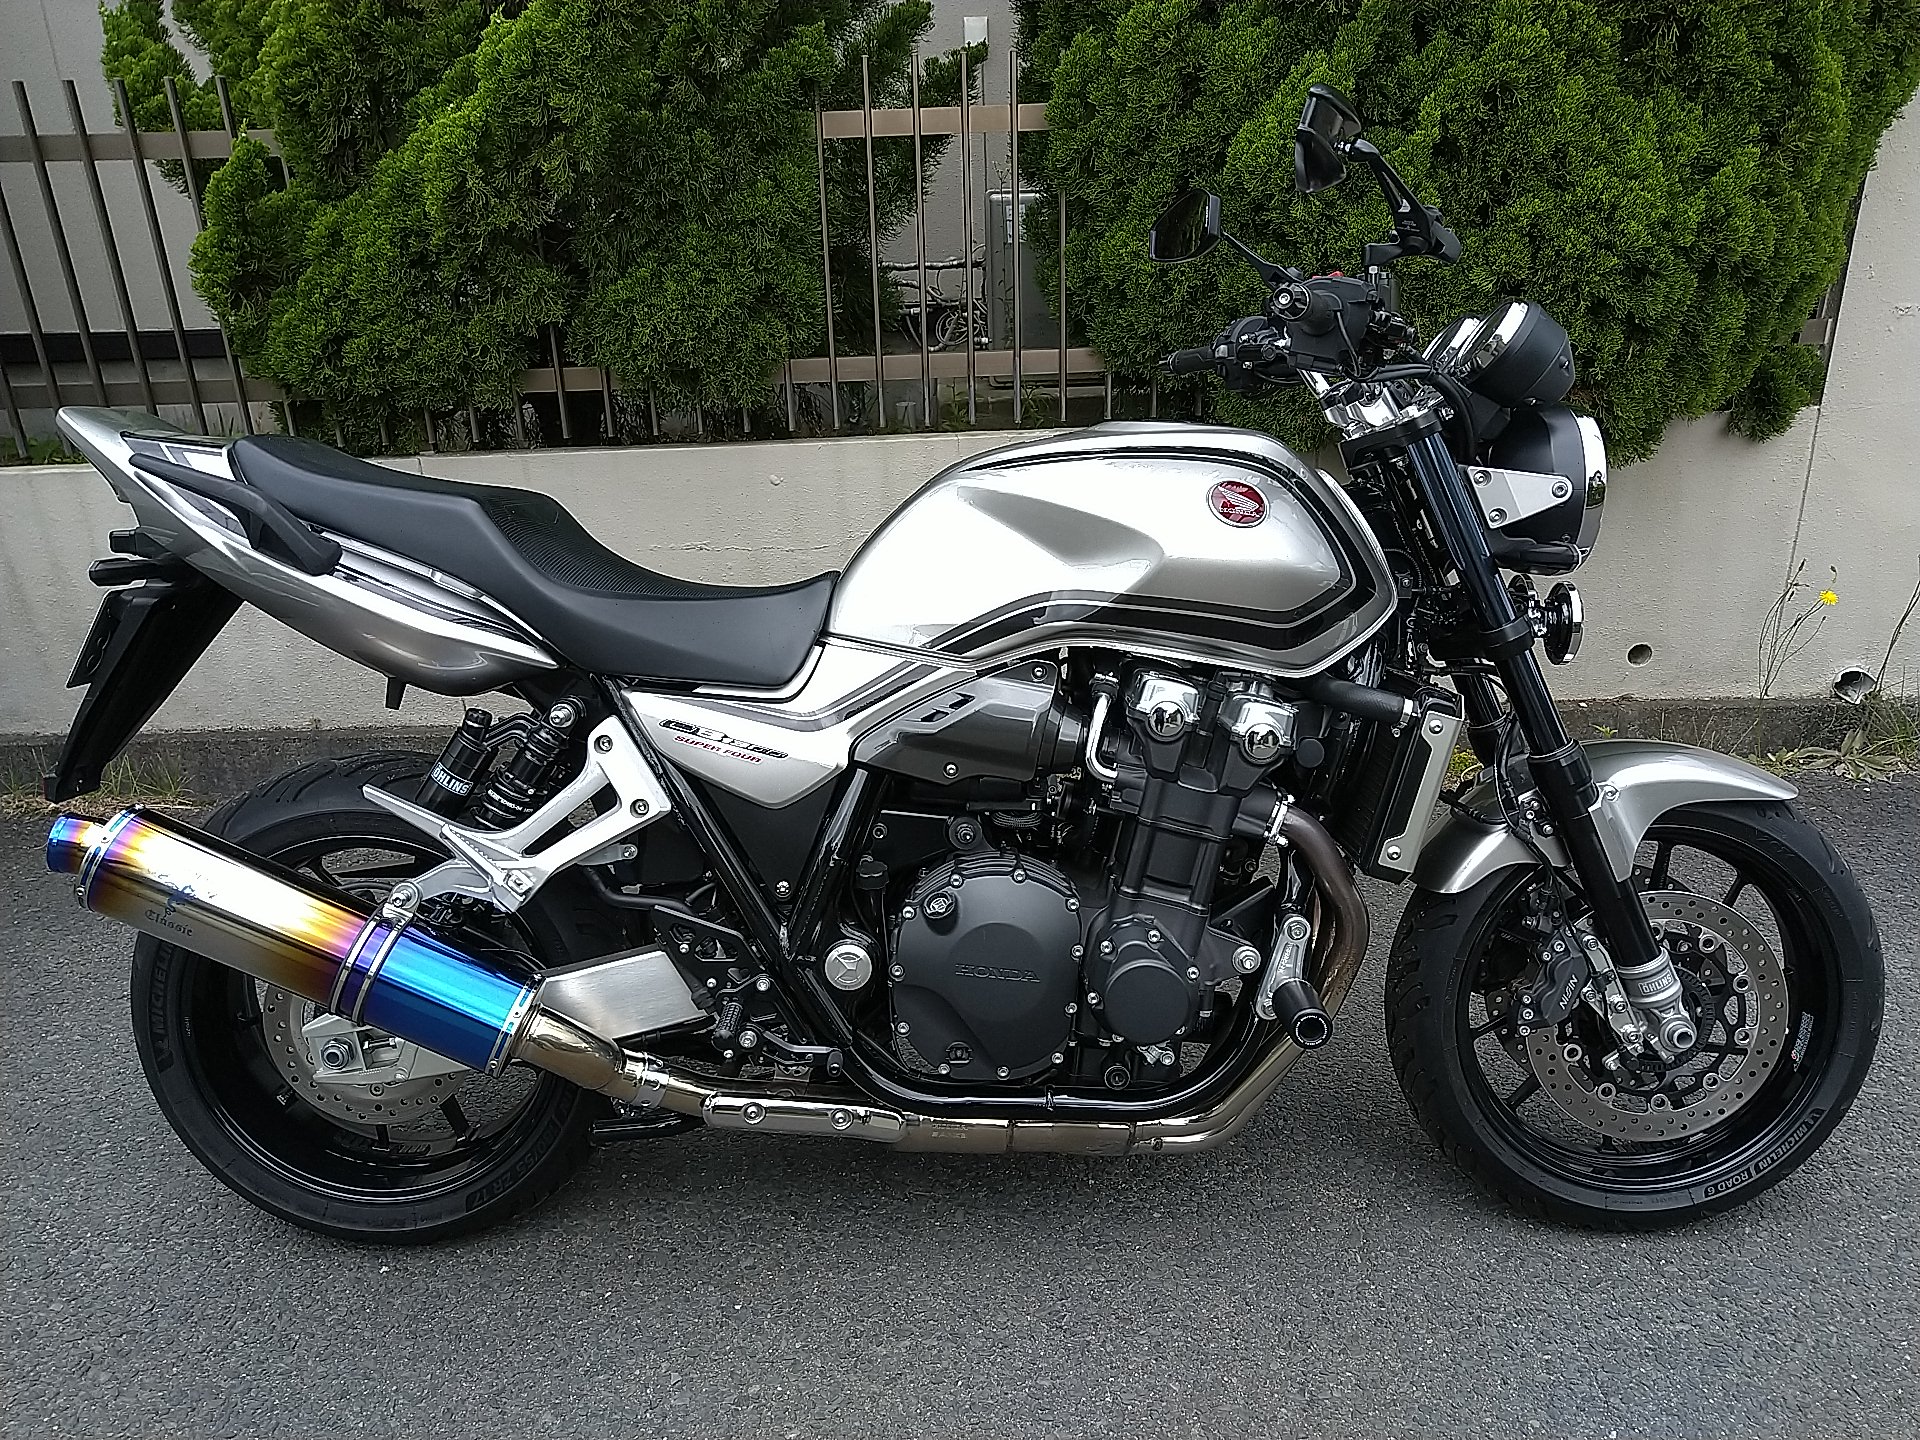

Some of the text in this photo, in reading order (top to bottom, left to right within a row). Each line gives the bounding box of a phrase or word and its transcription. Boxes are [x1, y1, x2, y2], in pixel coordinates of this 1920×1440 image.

[1219, 507, 1261, 518] HONDA
[674, 735, 762, 763] SUPER FOUR
[144, 909, 194, 937] Classic
[954, 963, 1041, 983] HONDA
[1641, 973, 1674, 994] ÖHLINS
[1706, 1122, 1810, 1196] MICHELIN ROAD 6
